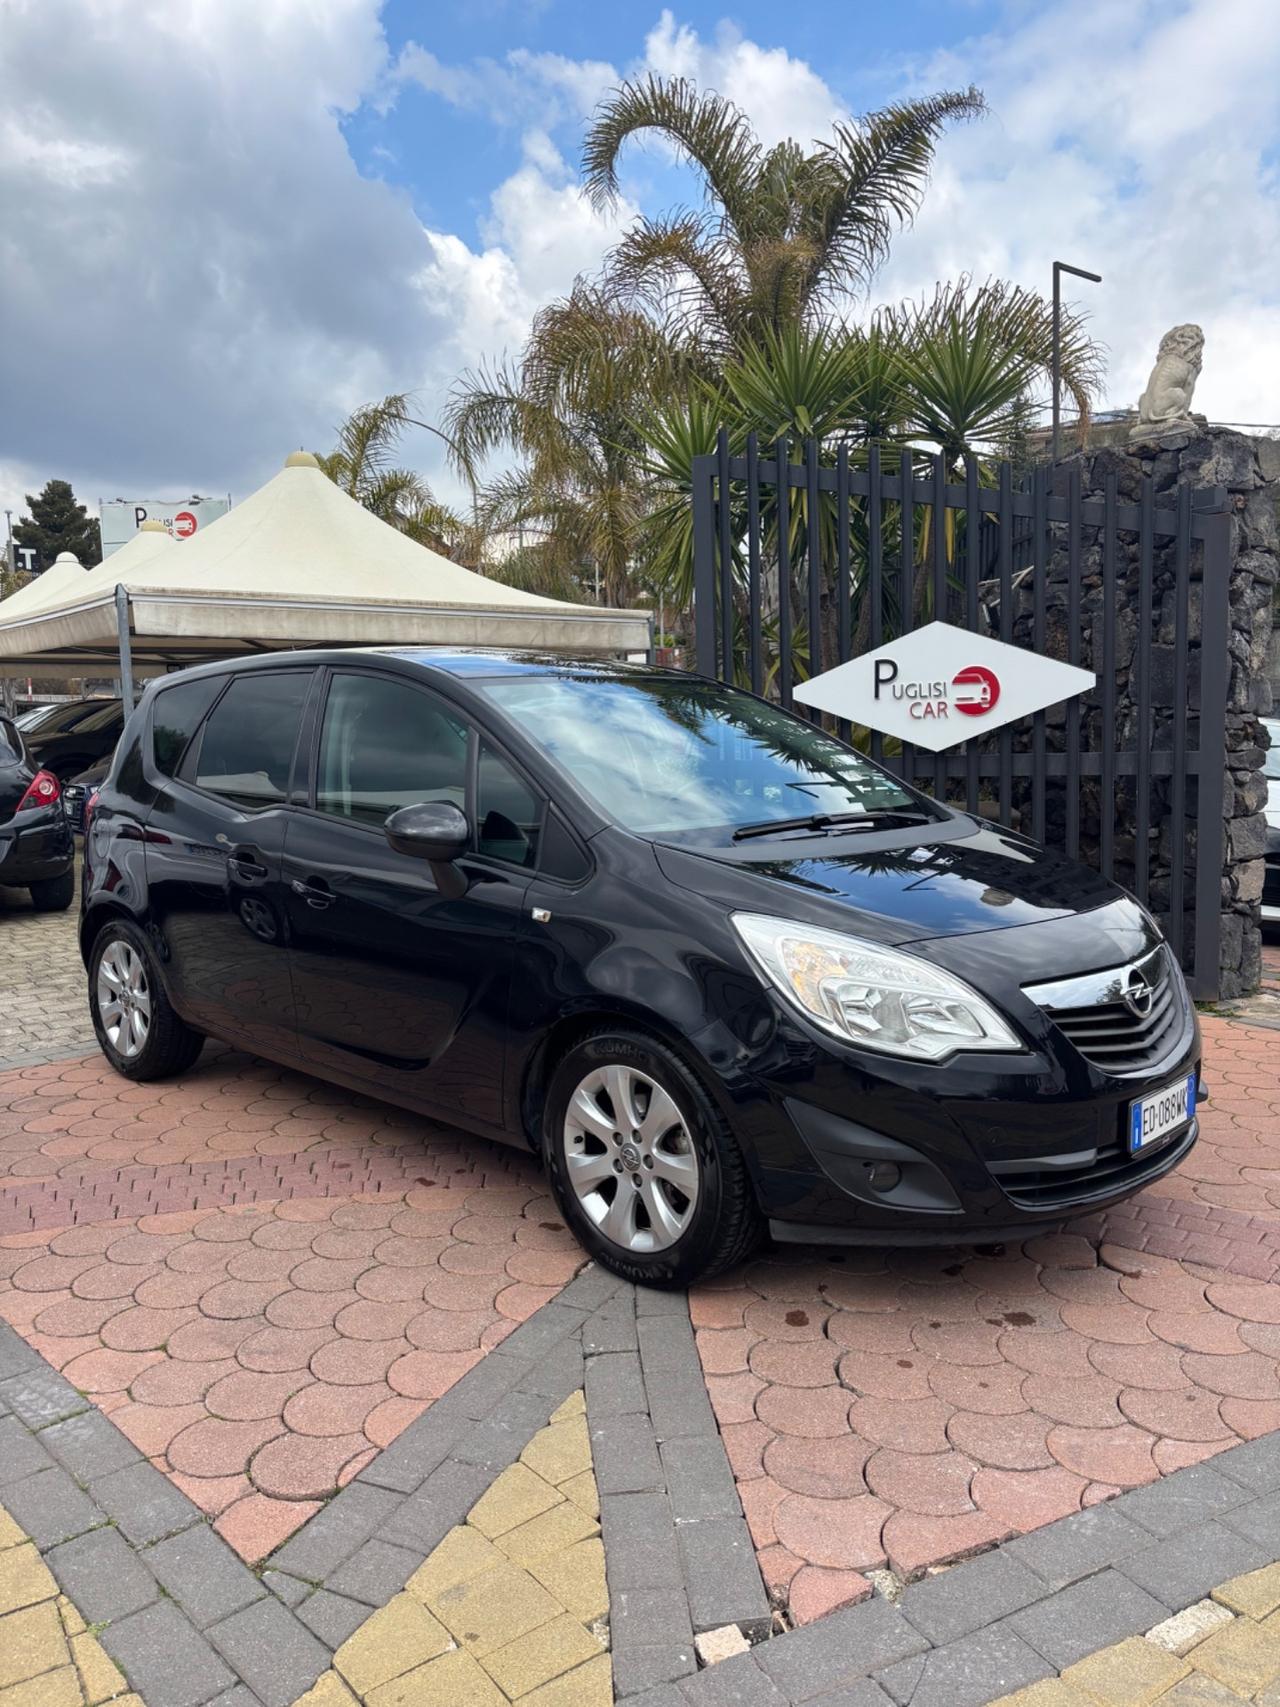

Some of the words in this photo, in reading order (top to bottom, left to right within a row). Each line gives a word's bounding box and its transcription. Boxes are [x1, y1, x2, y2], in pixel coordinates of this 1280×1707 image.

[135, 507, 173, 528] PISI
[874, 659, 947, 700] PUGLISI
[910, 701, 948, 719] CAR
